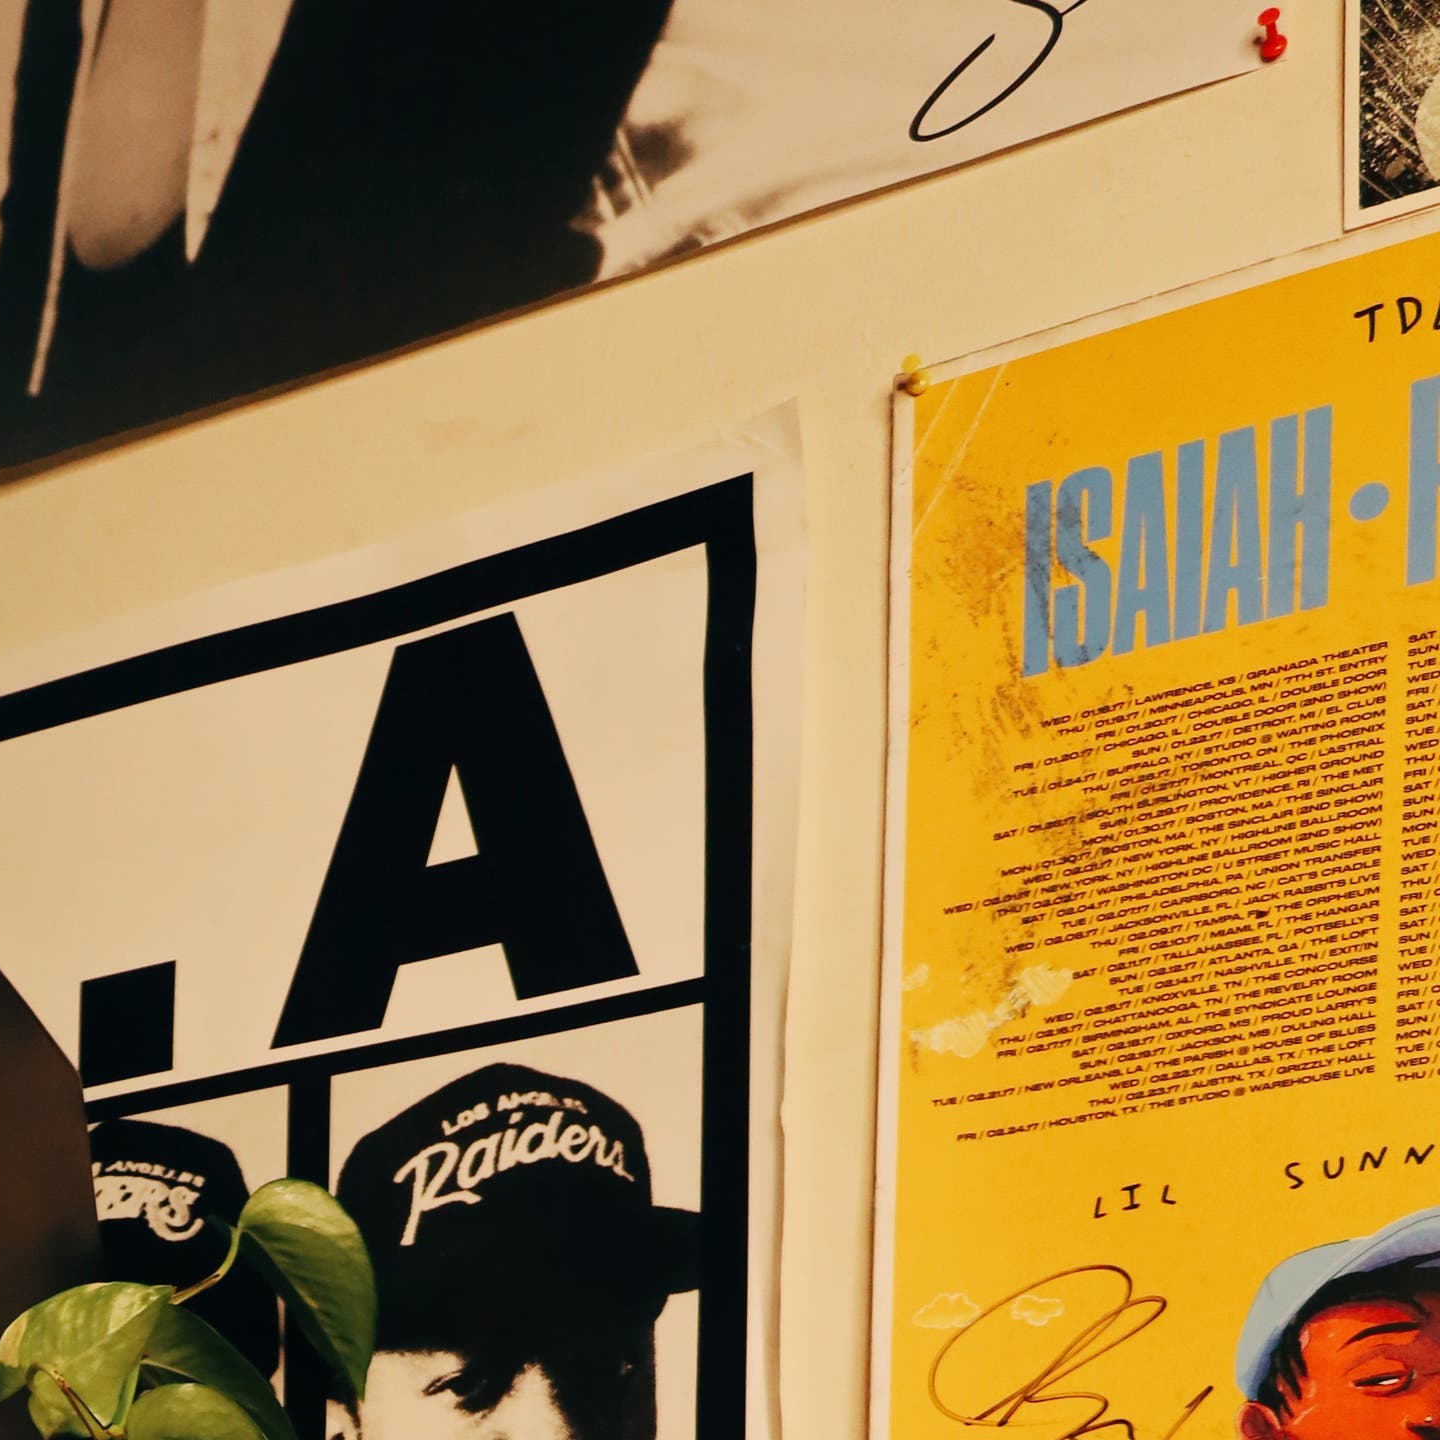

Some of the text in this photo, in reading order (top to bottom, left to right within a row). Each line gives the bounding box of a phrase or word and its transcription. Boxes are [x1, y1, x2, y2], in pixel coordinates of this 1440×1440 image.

[1022, 404, 1333, 678] ISAIAH
[1246, 640, 1387, 680] GRANADA THEATER
[1283, 670, 1312, 685] 7TH
[1339, 653, 1386, 672] ENTRY
[1280, 667, 1386, 699] DOUBLE DOOR
[1326, 694, 1386, 715] EL CLUB
[1288, 721, 1384, 750] THE PHOENIX
[1263, 748, 1384, 782] HIGHER GROUND
[1321, 762, 1383, 783] THE MET
[1285, 775, 1383, 804] THE SINCLAIR
[1231, 802, 1382, 841] HIGHLINE BALLROOM
[1223, 830, 1380, 870] U STREET MUSIC HALL
[1254, 843, 1381, 877] UNION TRANSFER
[1321, 857, 1380, 877] CRADLE
[1243, 870, 1379, 905] JACK RABBITS LIVE
[1274, 884, 1379, 913] THE ORPHEUM
[1284, 898, 1379, 924] THE HANGAR
[1310, 925, 1378, 947] THE LOFT
[1233, 966, 1377, 1001] THE REVELRY ROOM
[1253, 953, 1377, 984] THE CONCOURSE
[1204, 980, 1376, 1020] THE SYNDICATE LOUNGE
[1261, 1006, 1312, 1023] PROUD
[1281, 1008, 1375, 1033] DULING HALL
[1276, 1049, 1374, 1075] GRIZZLY HALL
[441, 1102, 491, 1137] LOS
[392, 1110, 636, 1247] Raiders
[1093, 1182, 1177, 1220] LIL
